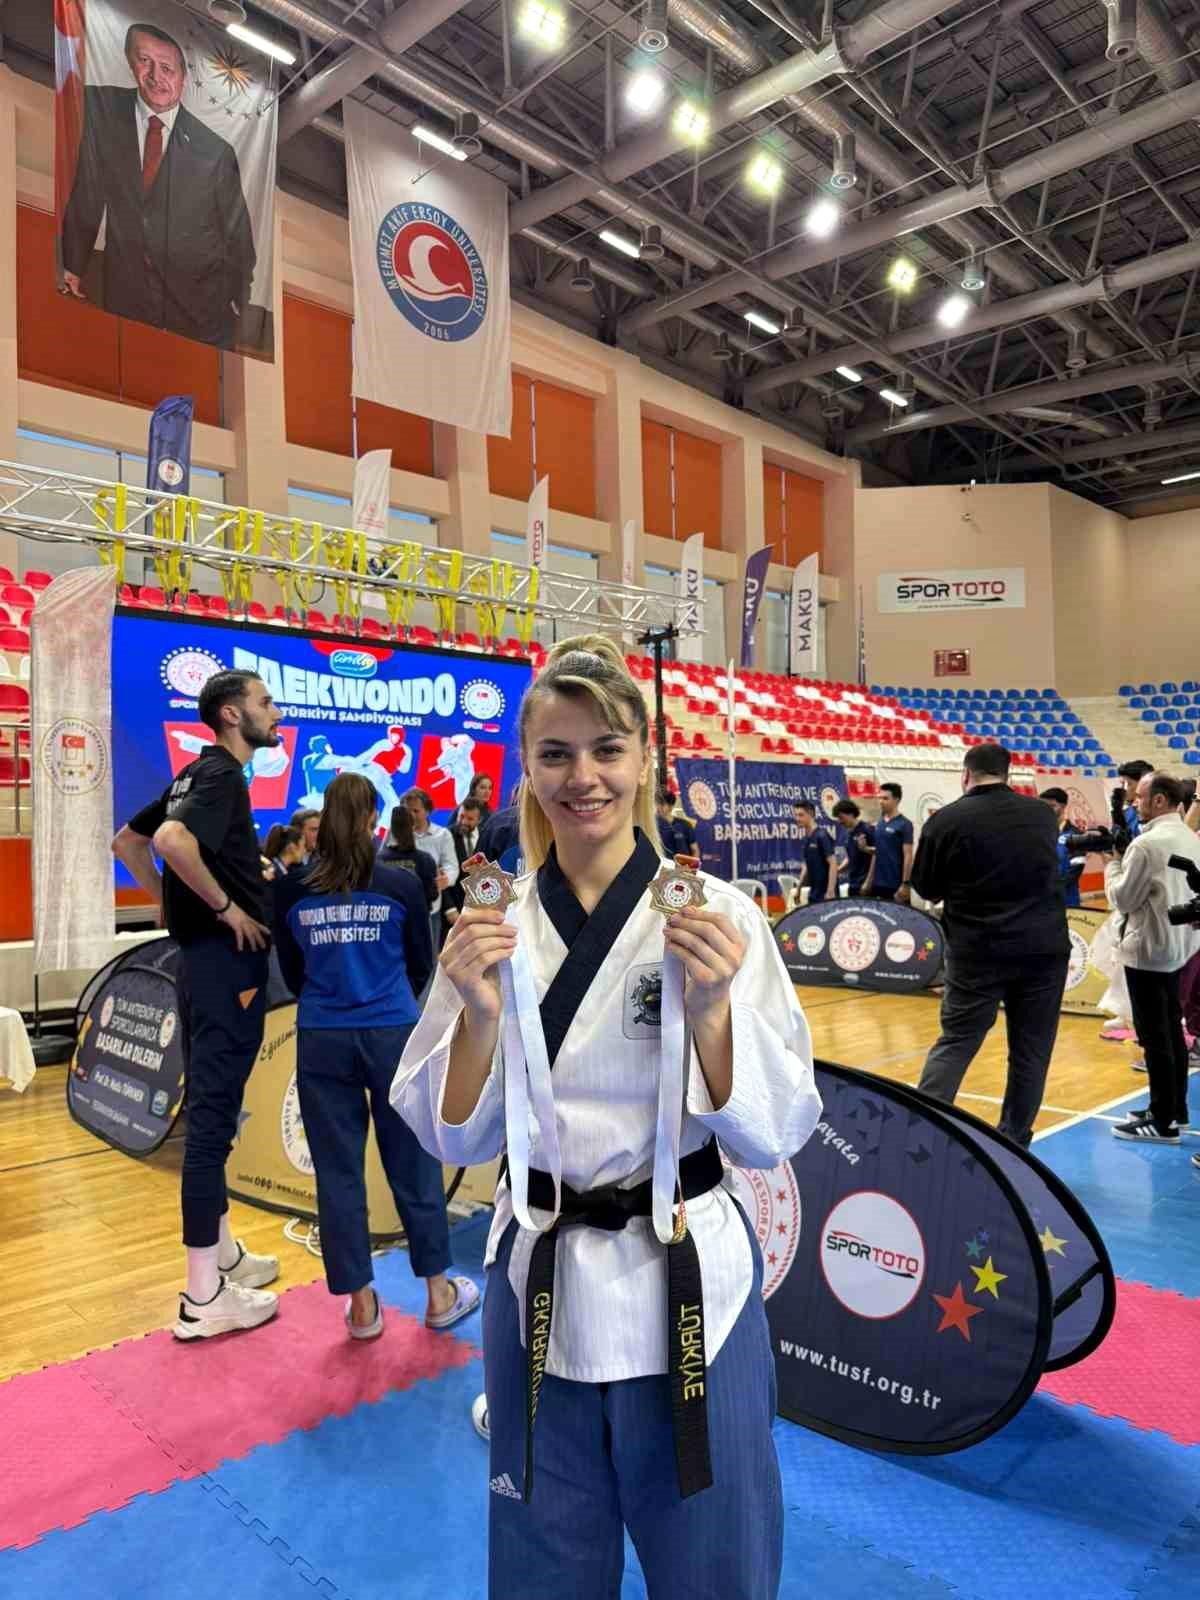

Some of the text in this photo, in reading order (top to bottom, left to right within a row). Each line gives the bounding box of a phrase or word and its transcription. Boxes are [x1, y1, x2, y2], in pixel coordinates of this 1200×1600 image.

[411, 205, 450, 229] ERSOY
[798, 588, 812, 652] MAKÜ
[280, 704, 422, 727] TÜRKİYE ŞAMPİYONASI
[802, 786, 817, 800] VE
[714, 823, 789, 843] BAŞARILAR
[816, 1120, 861, 1165] ayata
[779, 1338, 943, 1411] www.tusf.org.tr
